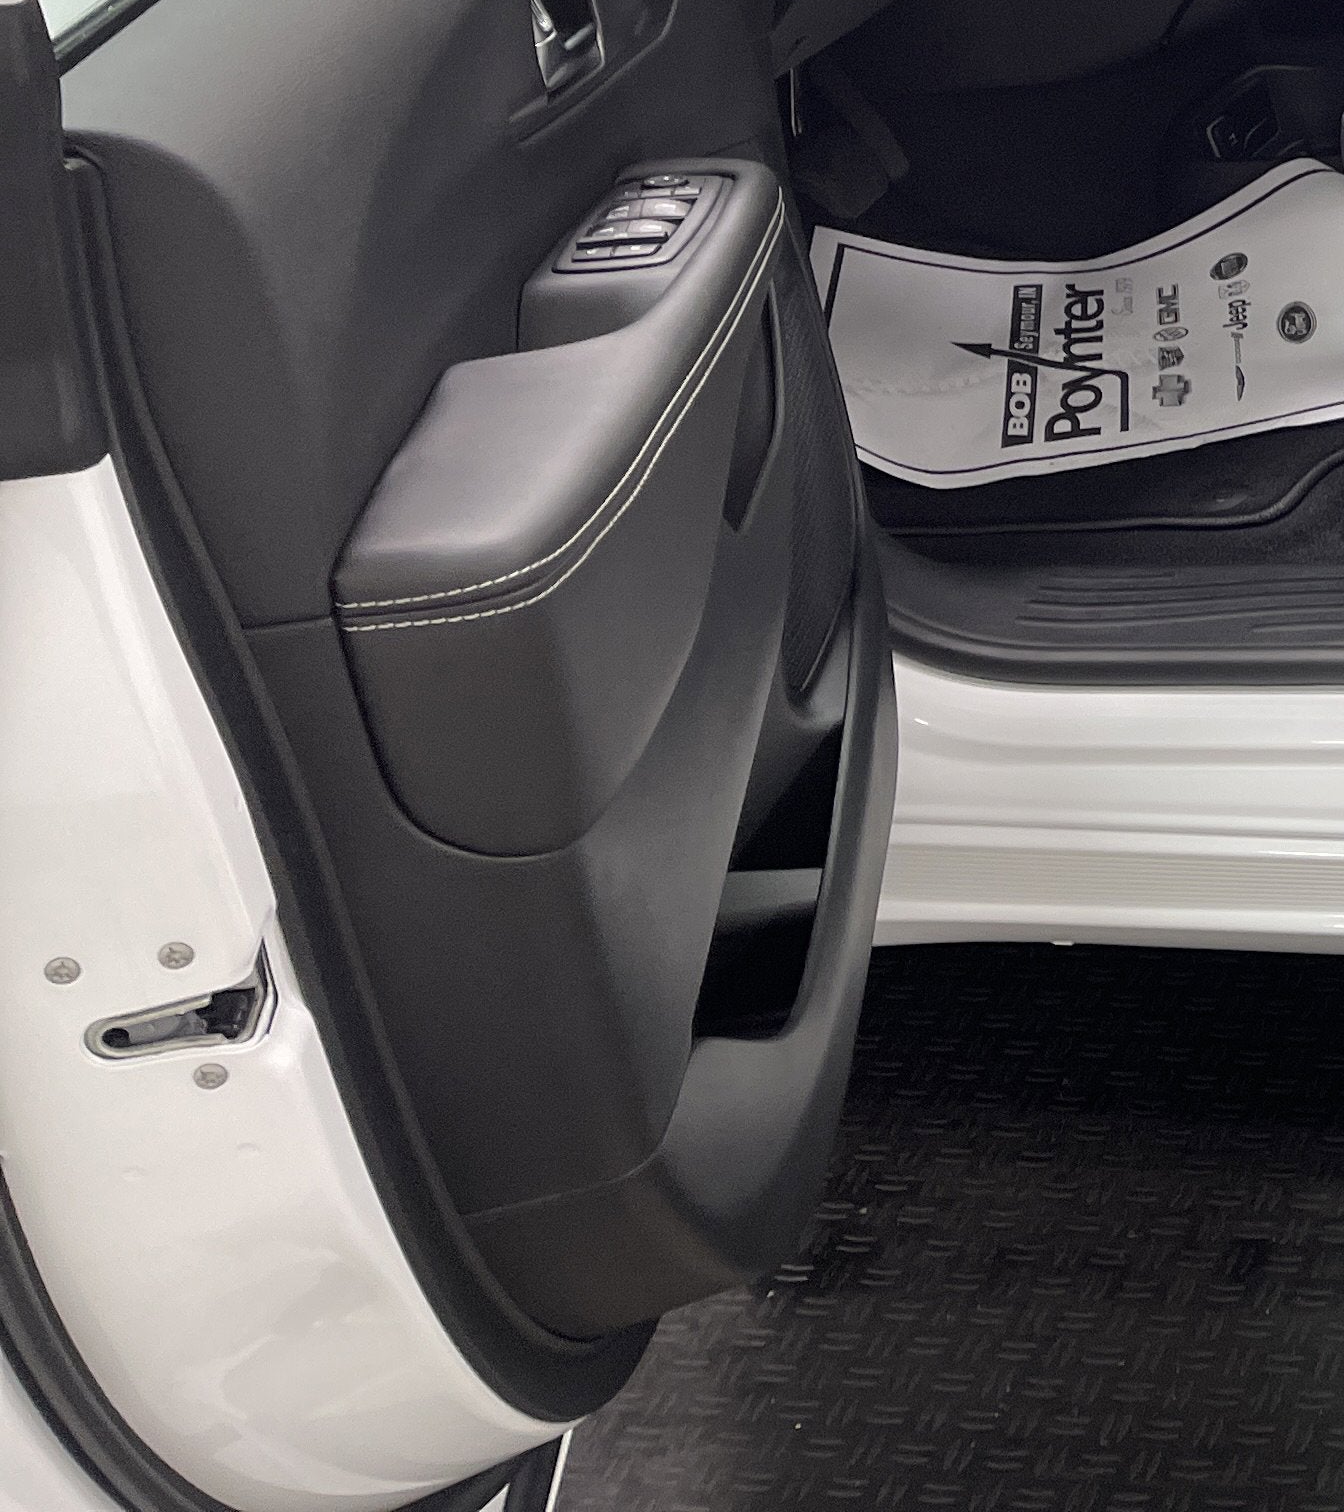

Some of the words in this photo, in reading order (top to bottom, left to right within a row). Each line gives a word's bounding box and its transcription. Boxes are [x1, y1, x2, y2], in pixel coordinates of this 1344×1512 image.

[1156, 283, 1180, 326] GMC
[1222, 299, 1251, 331] Jeep
[1044, 283, 1129, 443] Poynter
[1006, 372, 1032, 437] BOB
